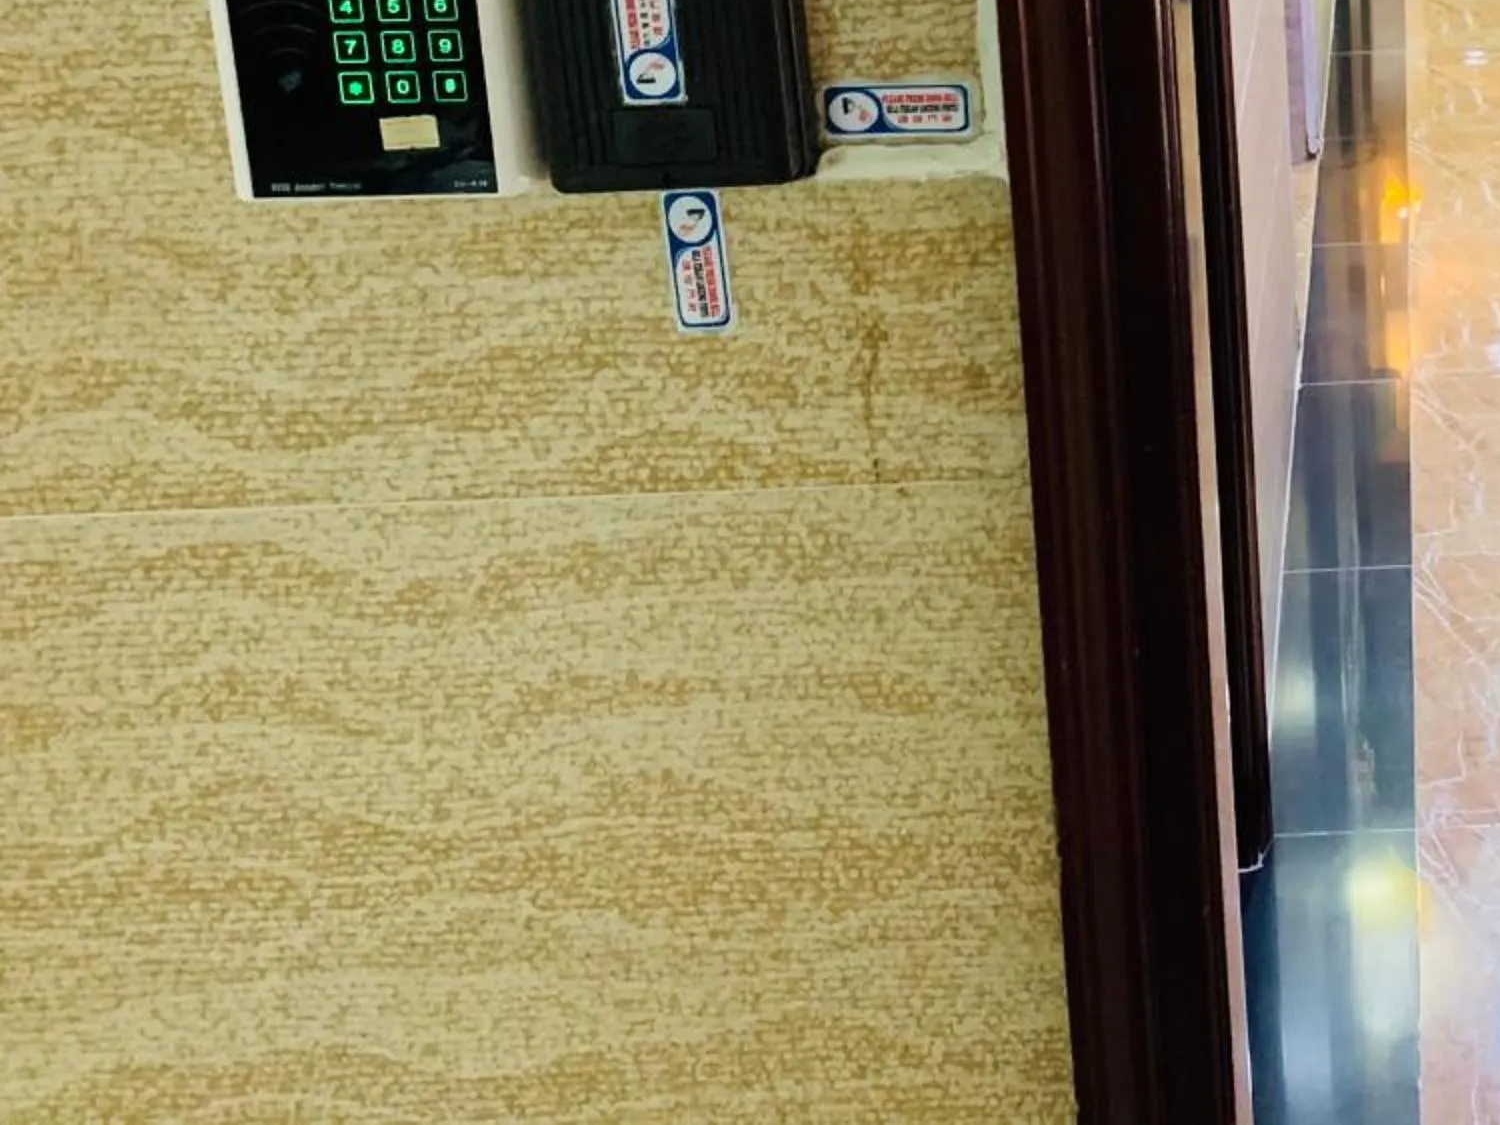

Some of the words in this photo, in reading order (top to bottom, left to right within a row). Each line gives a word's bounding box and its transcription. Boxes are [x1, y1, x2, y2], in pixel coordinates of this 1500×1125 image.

[338, 0, 353, 15] 4
[343, 39, 357, 56] 7
[391, 38, 405, 54] 8
[438, 38, 453, 54] 9
[396, 79, 410, 95] 0
